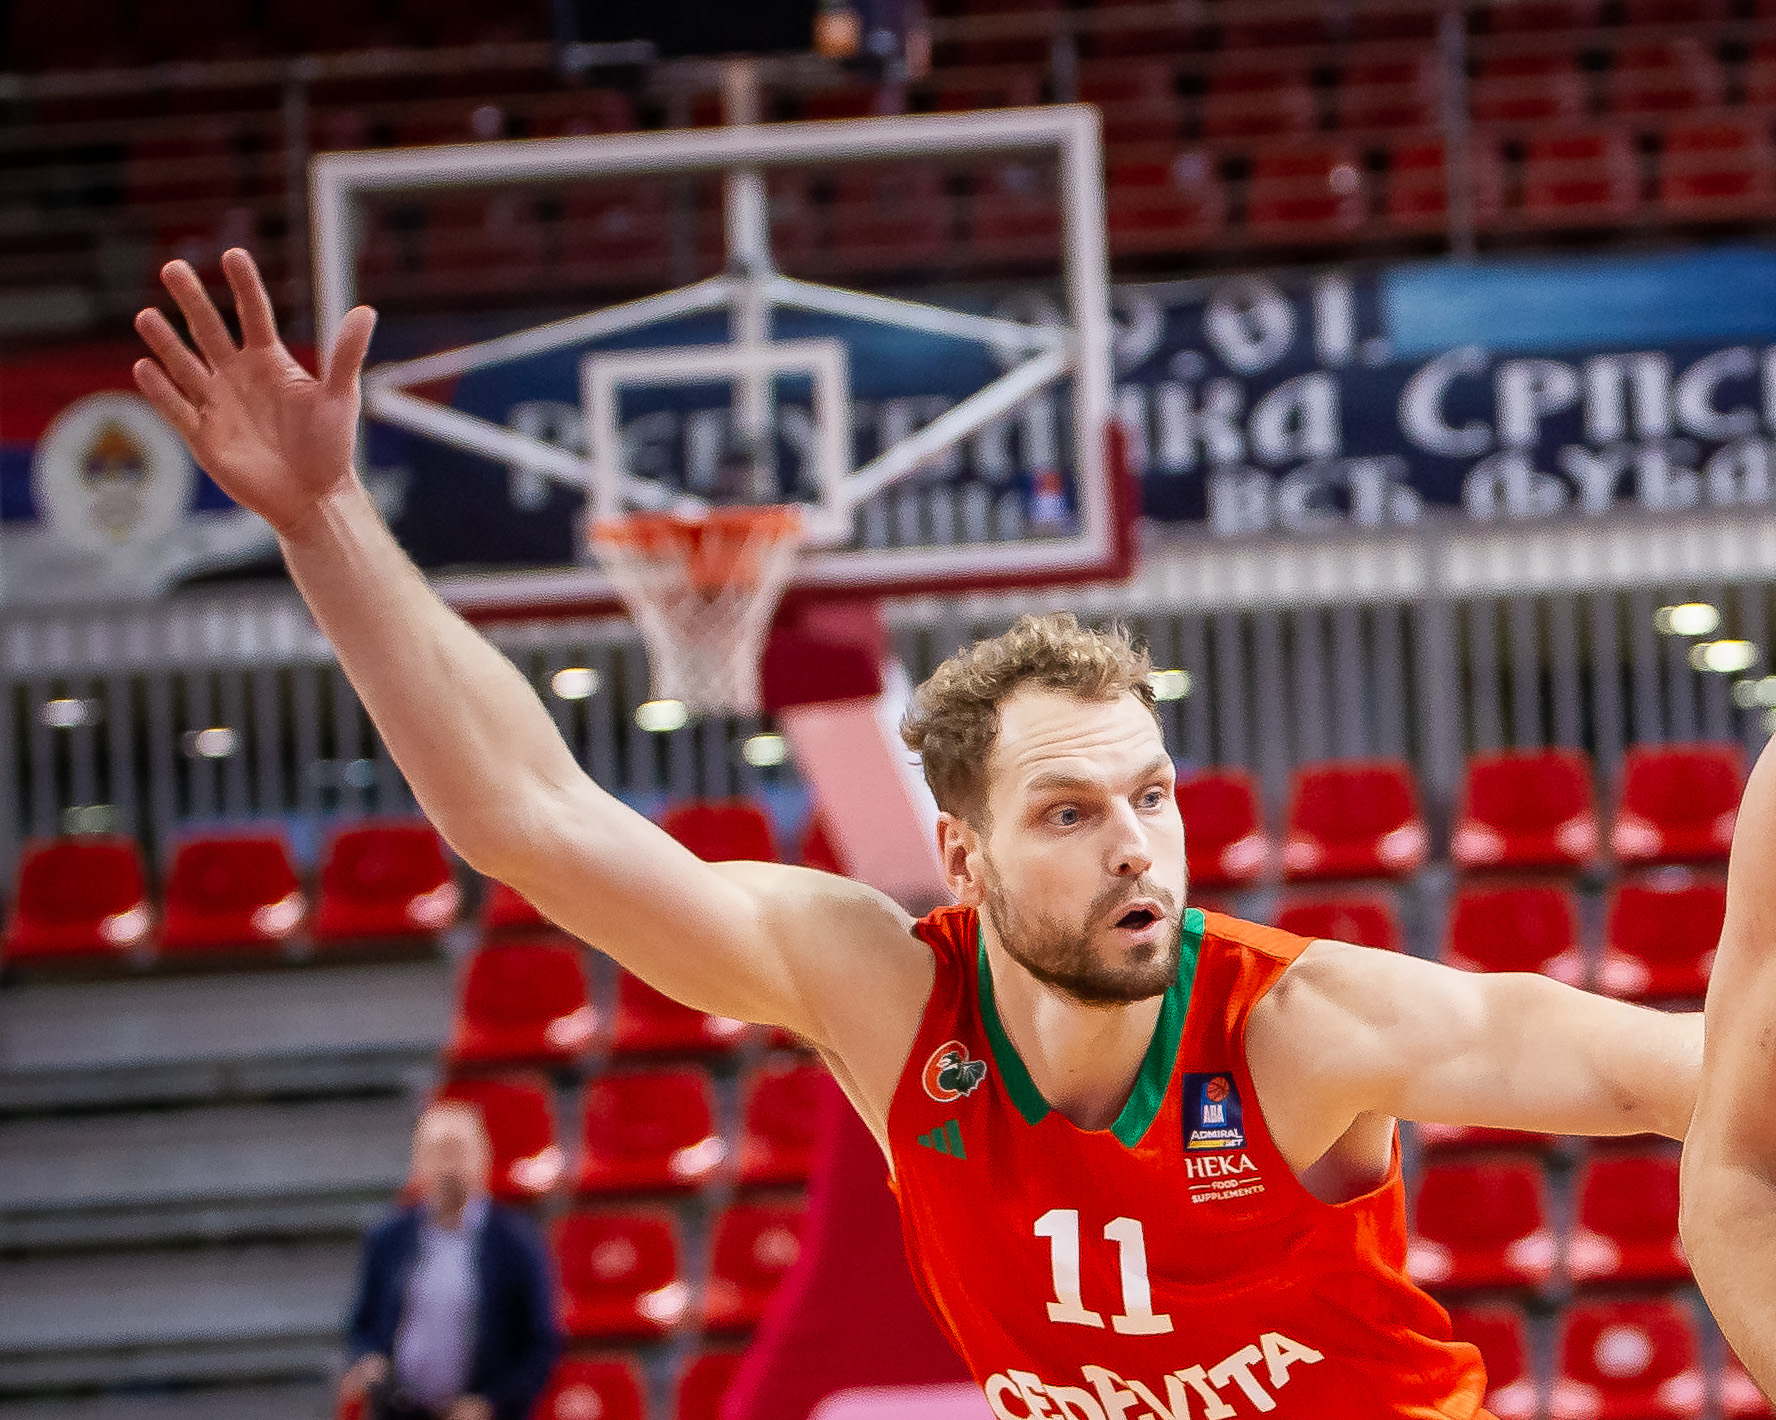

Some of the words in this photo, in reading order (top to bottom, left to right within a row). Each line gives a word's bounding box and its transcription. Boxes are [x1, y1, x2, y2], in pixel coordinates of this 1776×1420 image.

[1184, 1153, 1259, 1179] HEKA
[1190, 1184, 1266, 1204] SUPPLEMENTS
[1211, 1179, 1240, 1190] FOOD
[1033, 1208, 1174, 1336] 11
